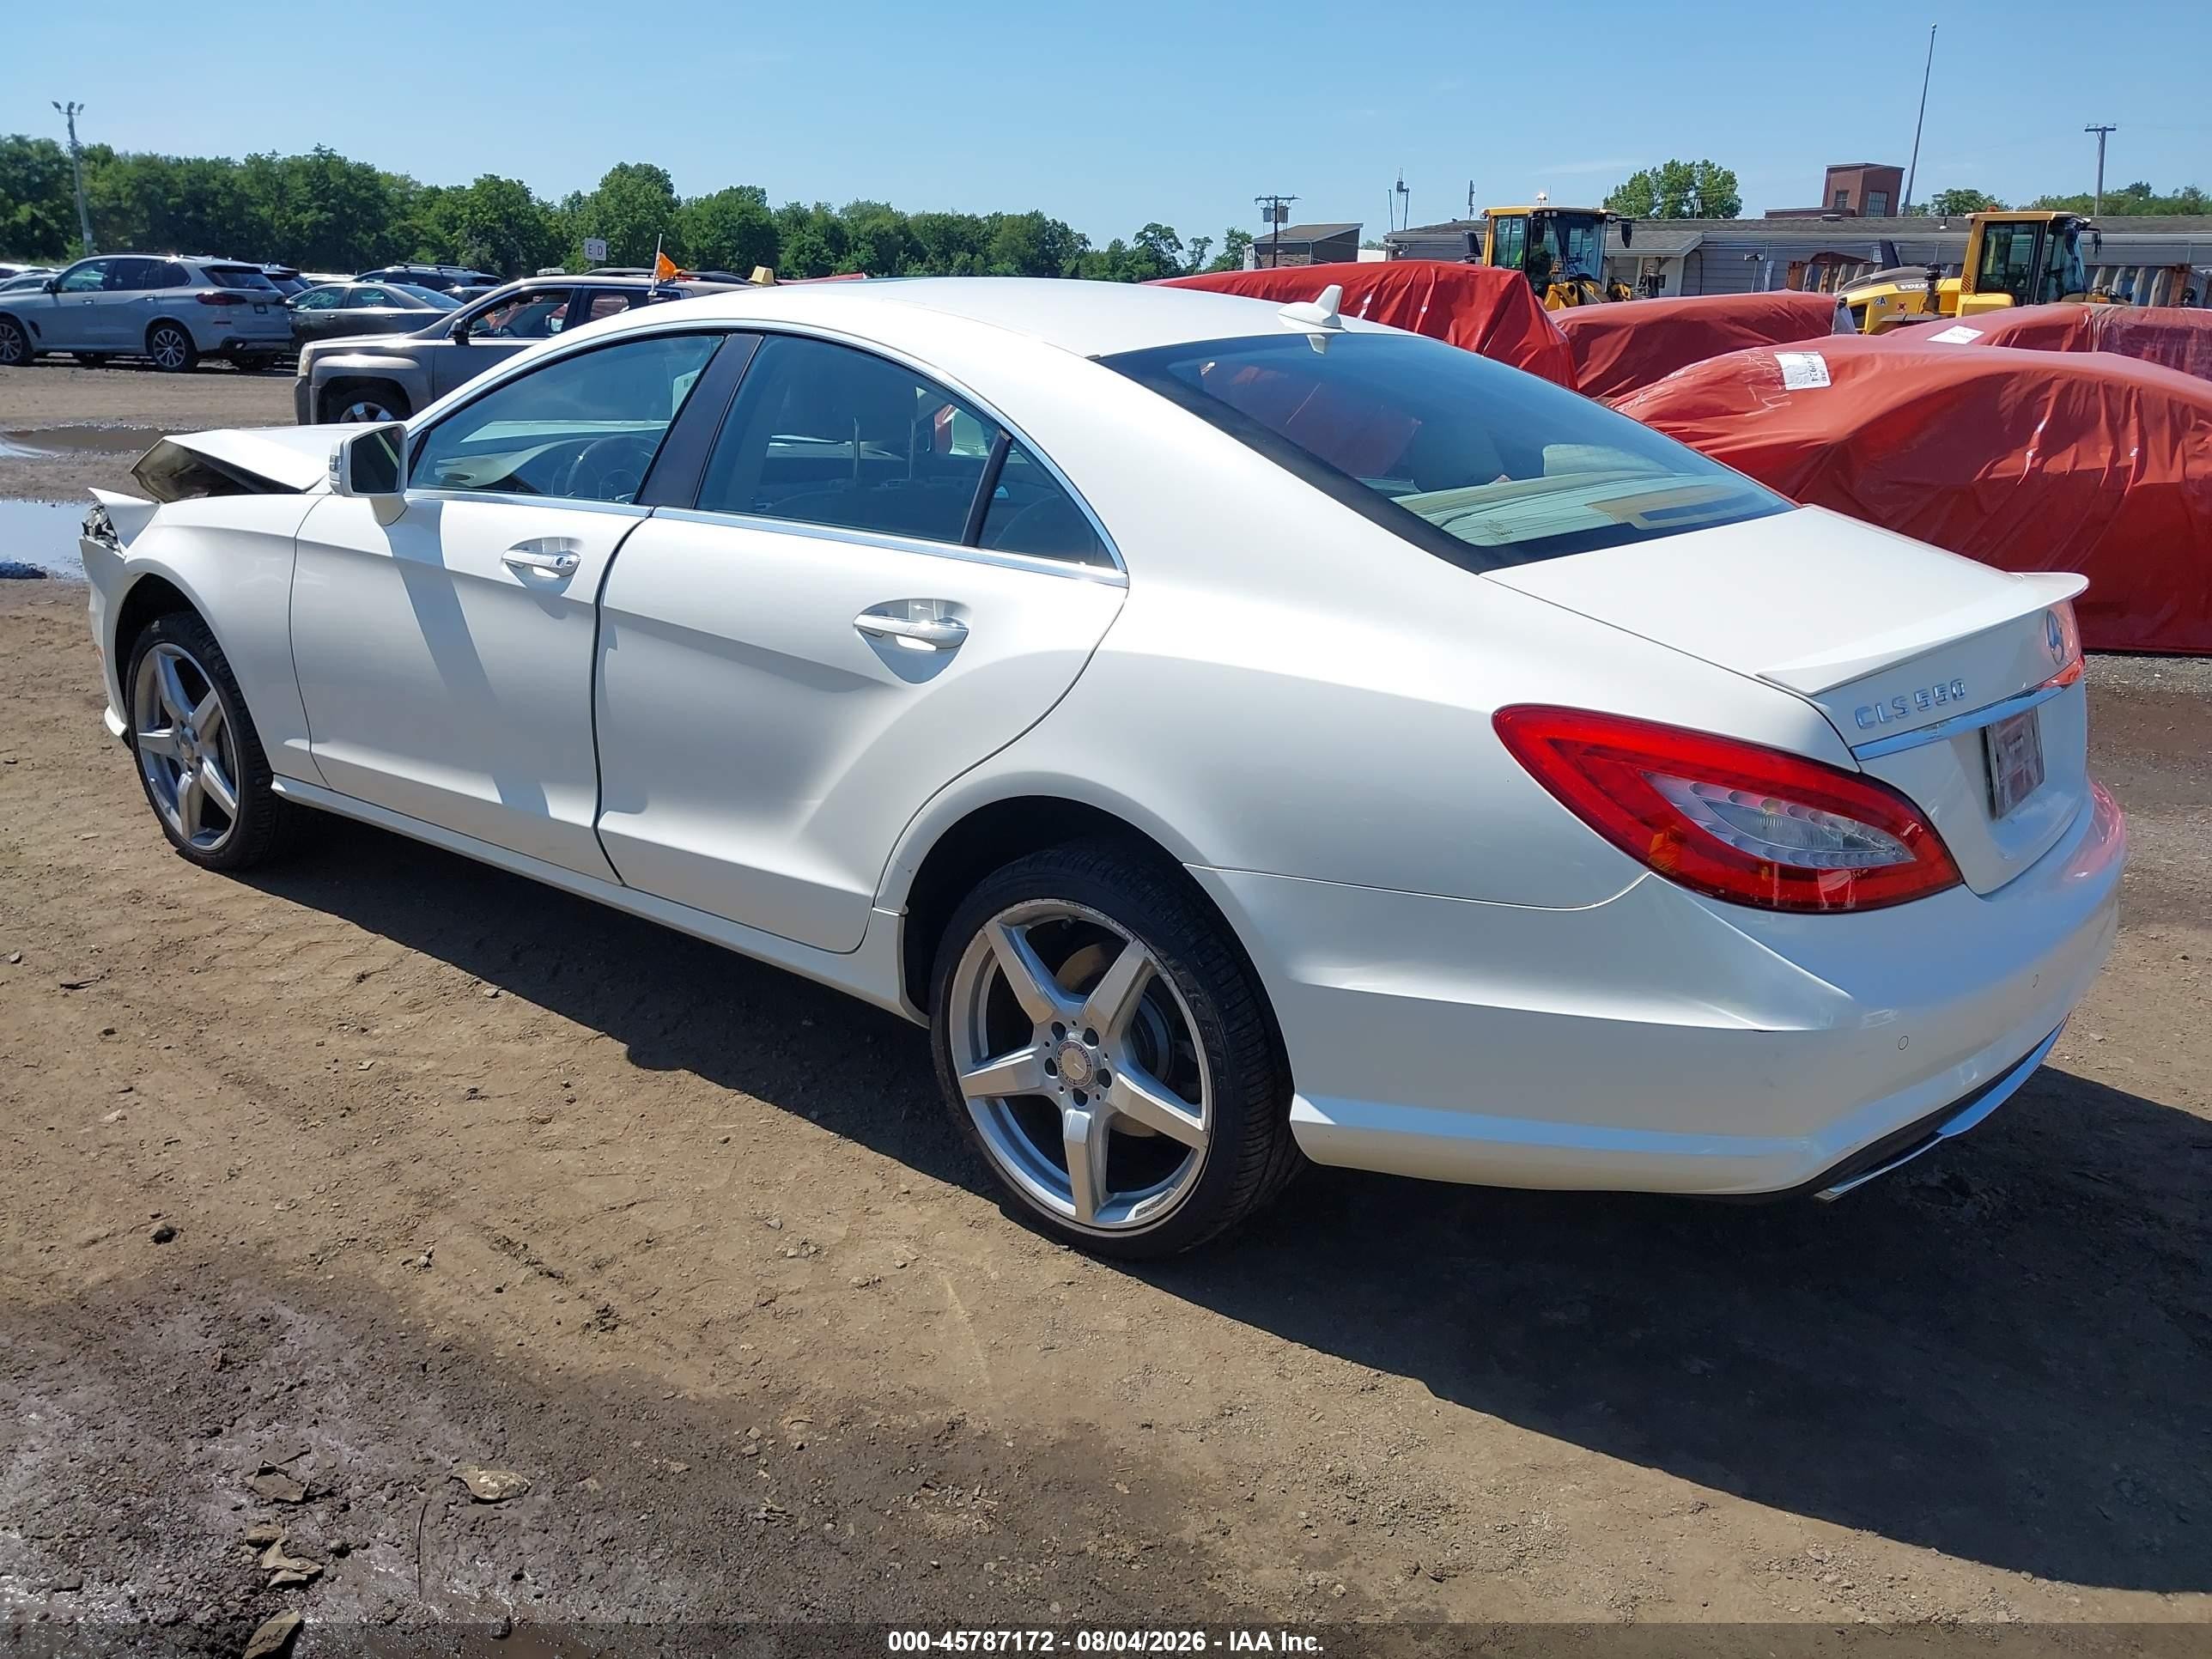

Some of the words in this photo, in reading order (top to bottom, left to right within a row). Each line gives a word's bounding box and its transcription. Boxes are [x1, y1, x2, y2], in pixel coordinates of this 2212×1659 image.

[588, 244, 593, 255] E
[598, 246, 604, 256] D
[1855, 696, 1910, 730] CLS
[1913, 678, 1966, 713] 550
